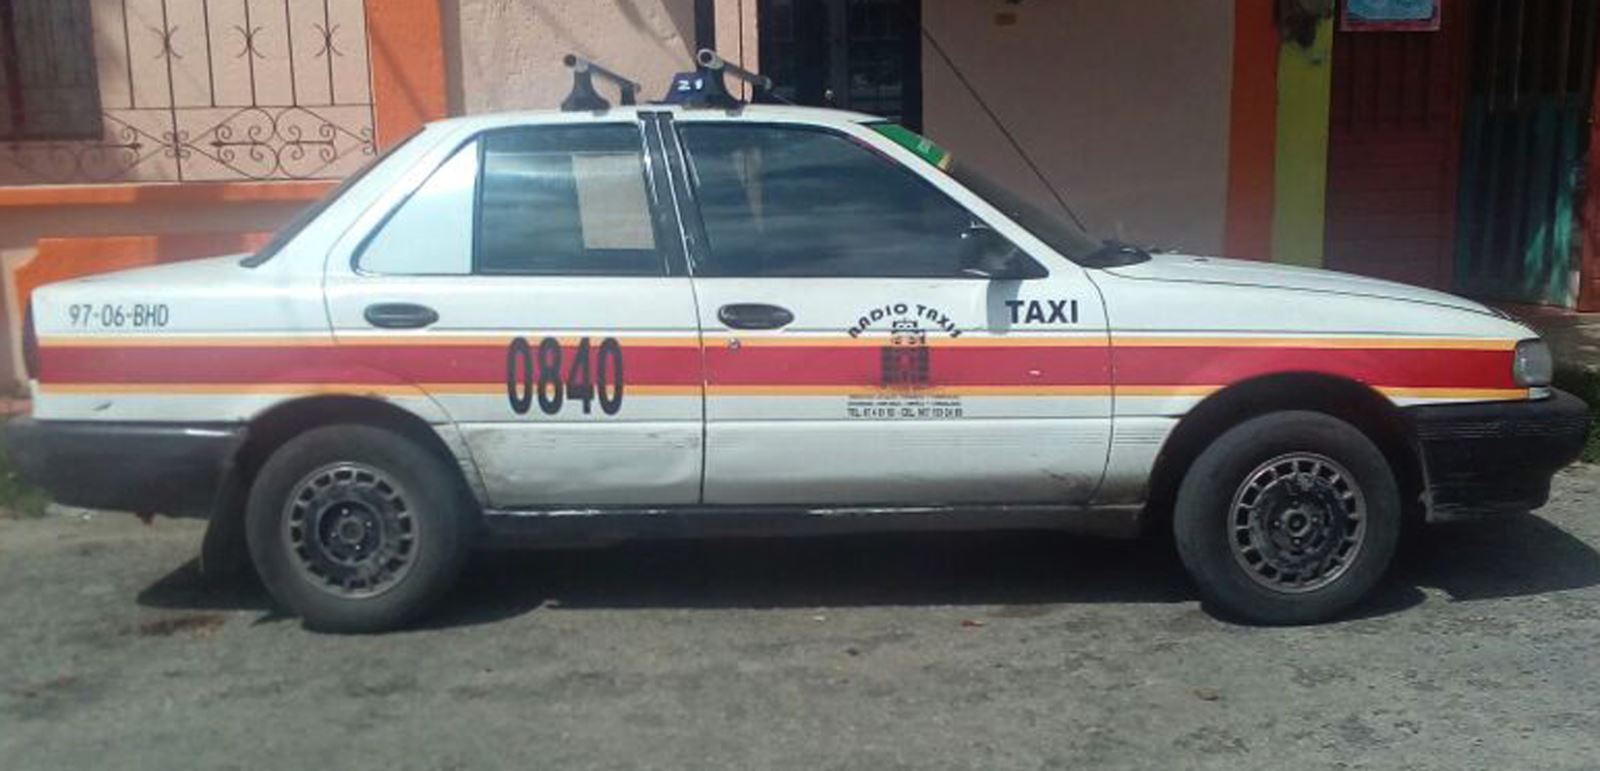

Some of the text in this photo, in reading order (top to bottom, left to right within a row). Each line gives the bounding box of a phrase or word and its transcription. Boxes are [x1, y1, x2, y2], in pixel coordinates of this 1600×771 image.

[68, 303, 170, 327] 97-06-BHD
[848, 303, 962, 338] RADIO TAXIS
[1004, 300, 1079, 324] TAXI
[506, 336, 624, 416] 0840
